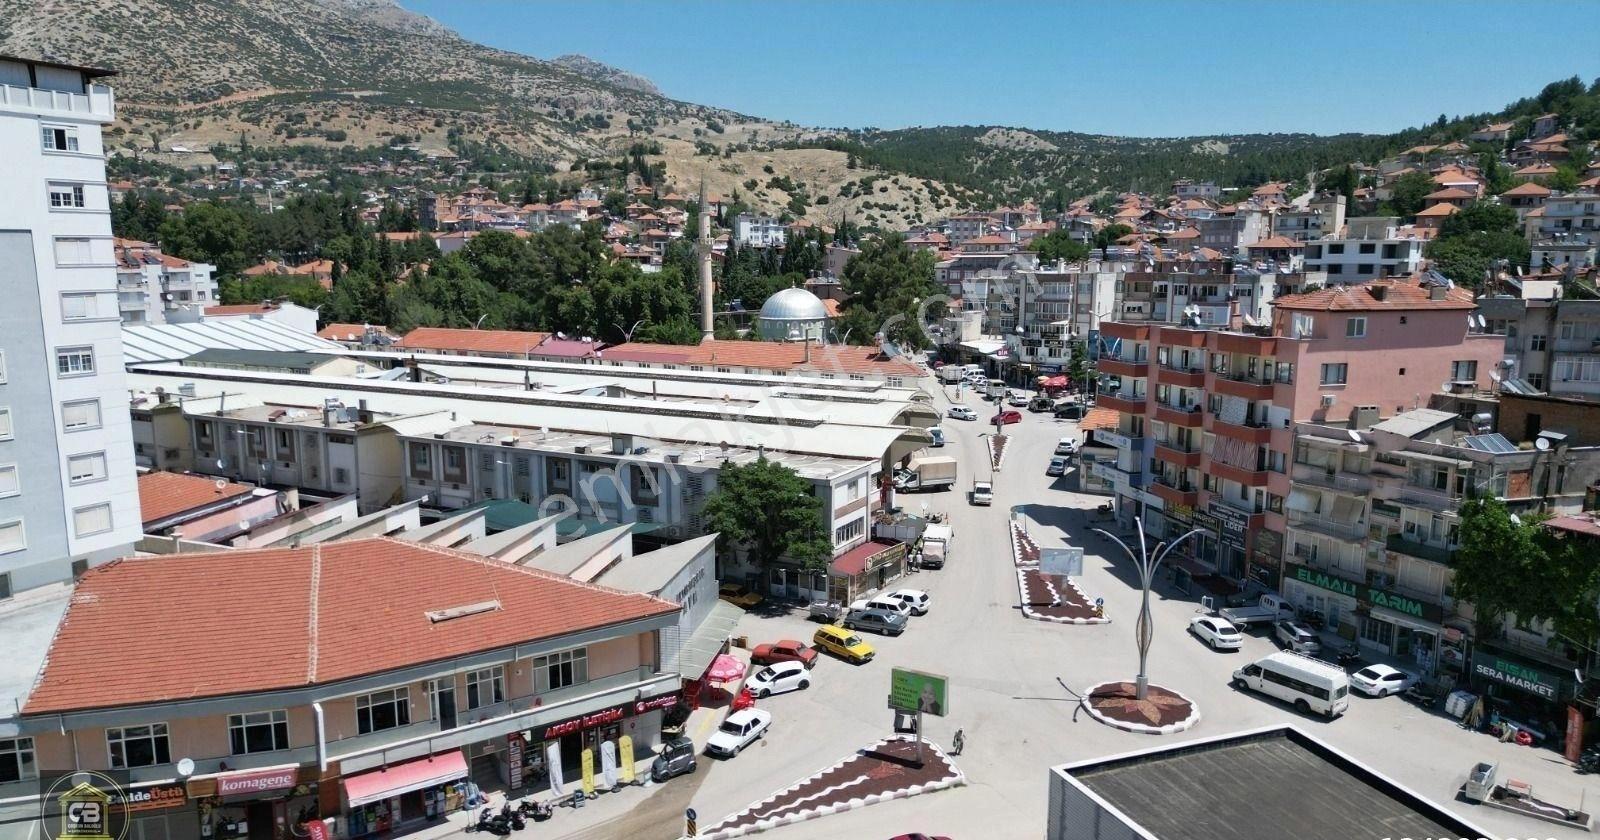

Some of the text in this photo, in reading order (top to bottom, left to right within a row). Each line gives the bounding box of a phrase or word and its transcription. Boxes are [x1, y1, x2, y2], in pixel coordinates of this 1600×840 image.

[1297, 568, 1423, 617] ELMALI TARIM
[1476, 664, 1555, 698] SERA MARKET
[221, 773, 292, 791] komagene
